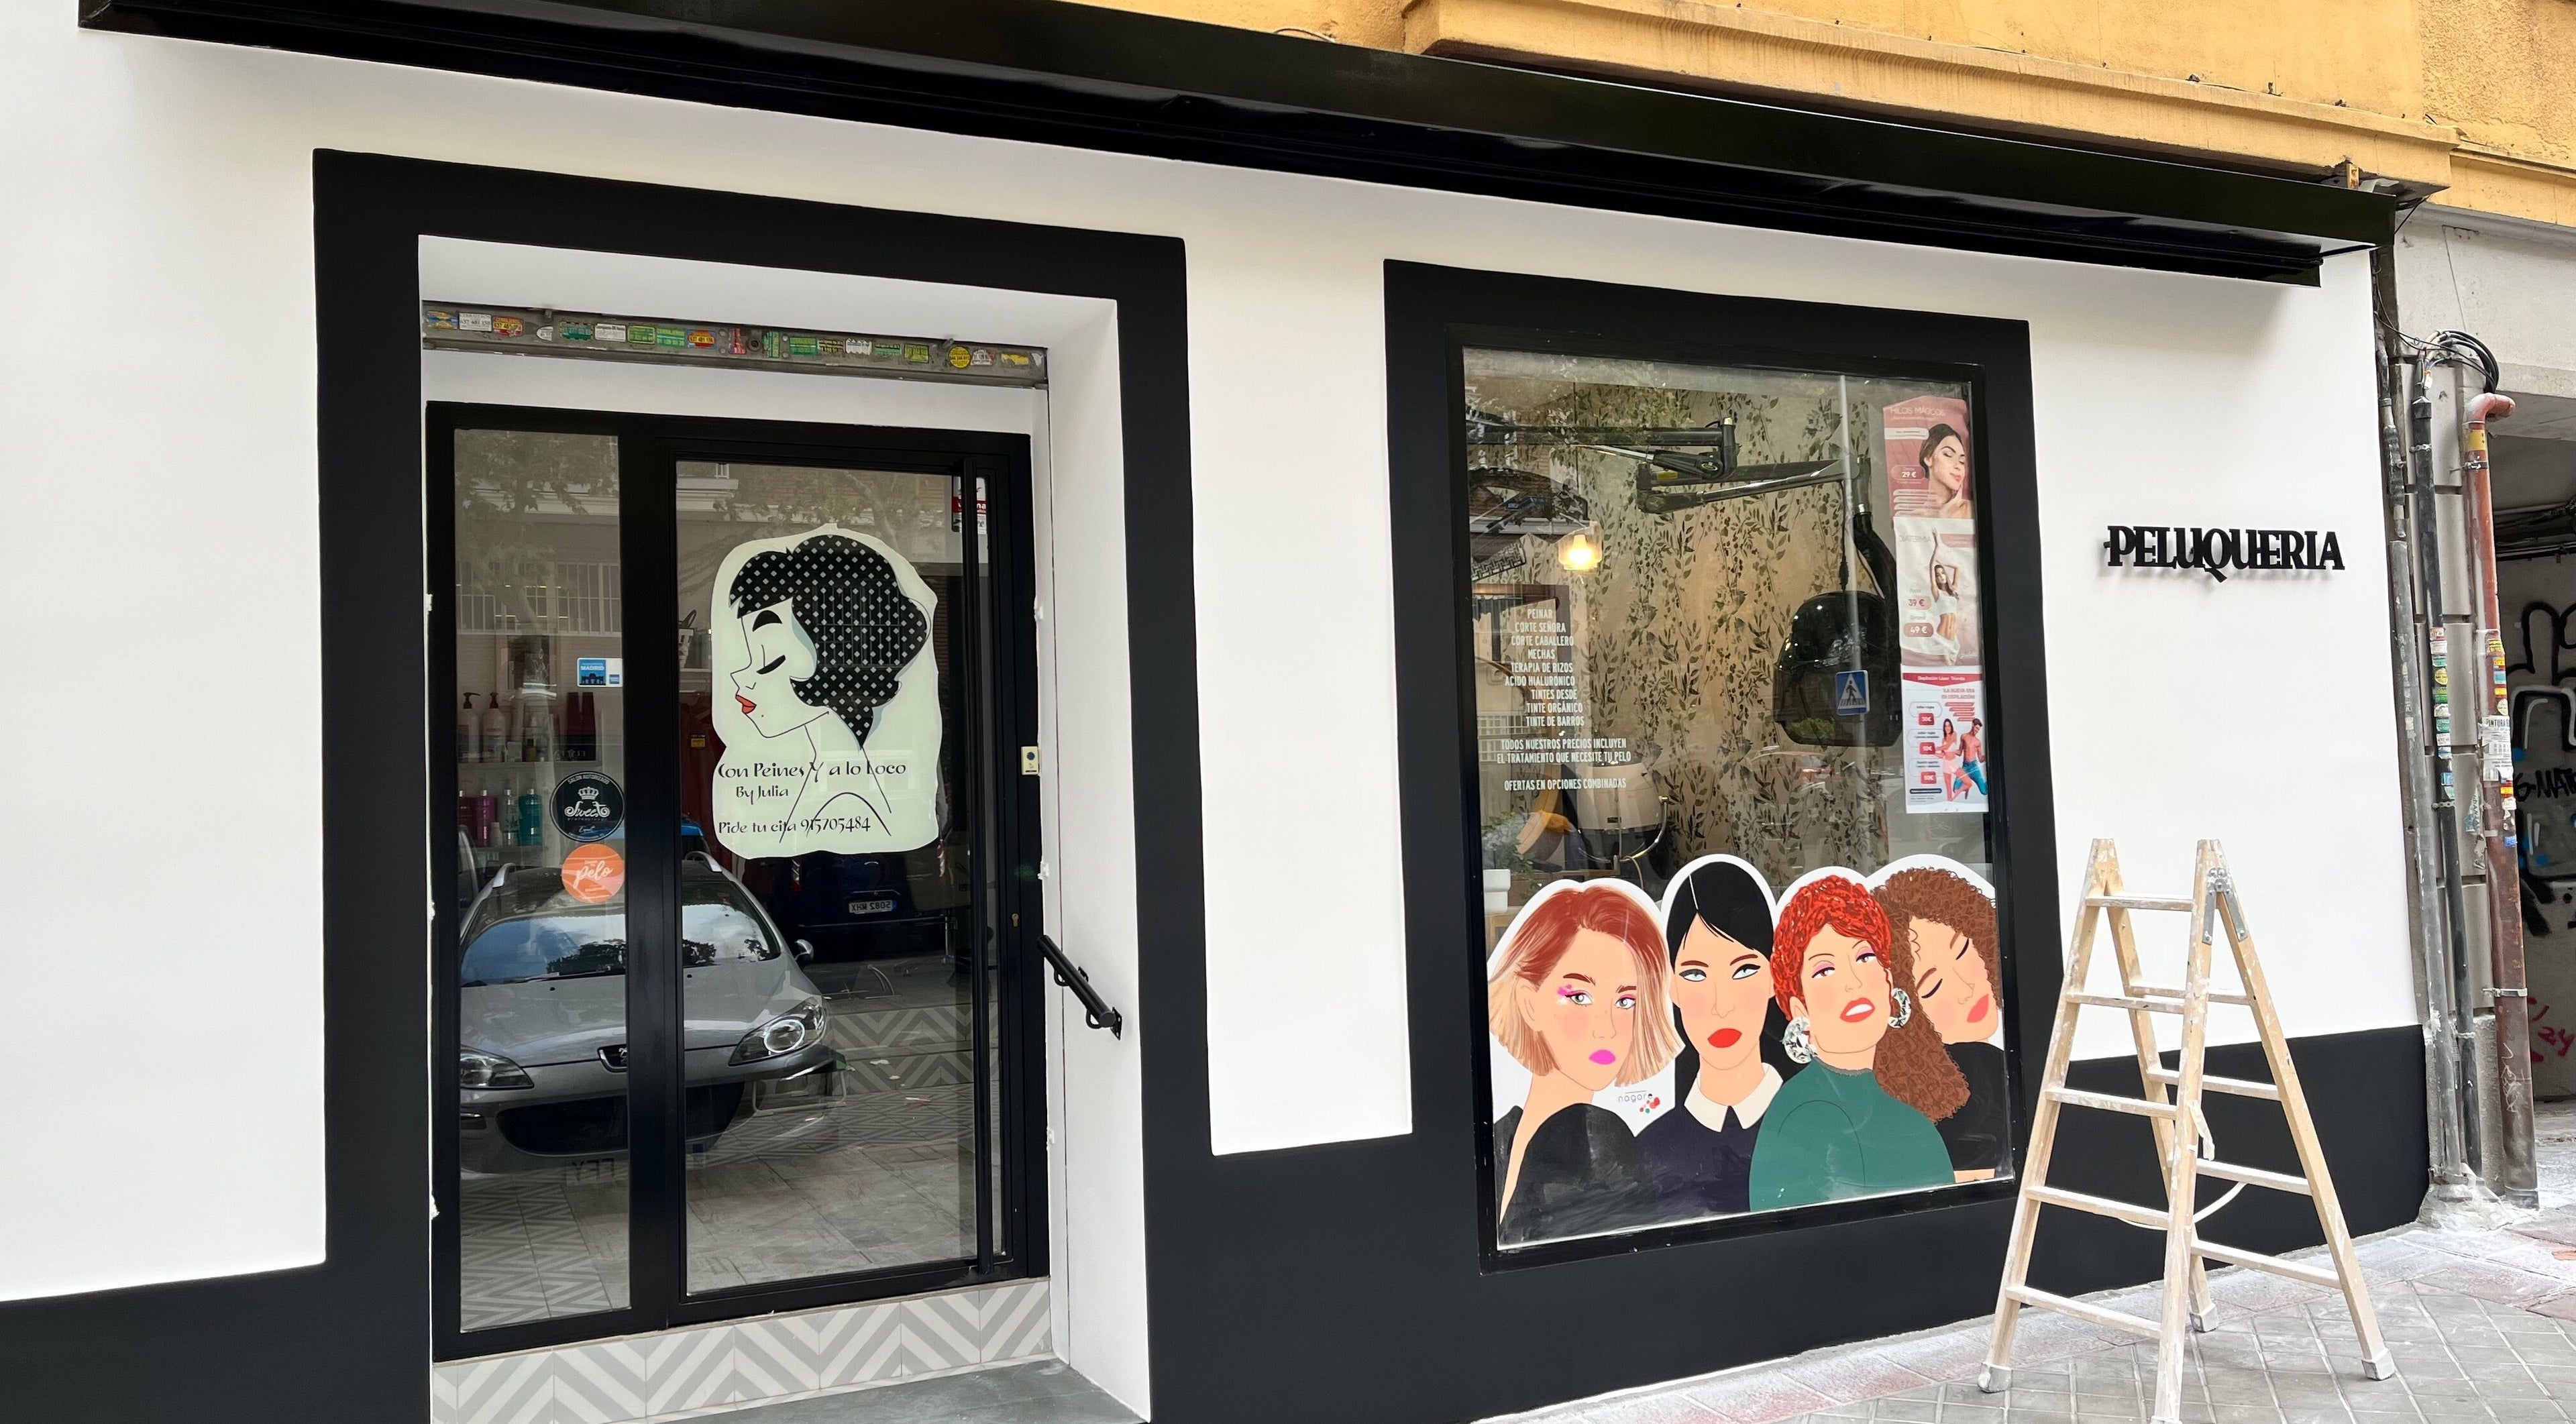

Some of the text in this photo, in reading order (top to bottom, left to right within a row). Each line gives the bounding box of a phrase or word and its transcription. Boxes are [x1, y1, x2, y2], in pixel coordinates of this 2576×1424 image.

[2107, 525, 2346, 583] PELUQUERIA
[1527, 608, 1553, 619] PEINAR
[1515, 621, 1566, 633] CORTE SEÑORA
[1910, 626, 1920, 635] 49
[1511, 636, 1574, 647] CORTE CABALLERO
[1527, 649, 1556, 659] MECHAS
[1511, 662, 1573, 673] TERAPIA DE RIZOS
[1505, 675, 1575, 686] ACIDO HIALURONICO
[1531, 689, 1578, 700] TINTES DESDE
[1526, 701, 1583, 713] TINTE ORGÁNICO
[1525, 716, 1585, 726] TINTE DE BARROS
[1501, 738, 1627, 750] TODOS NUESTROS PRECIOS INCLUYEN
[1497, 751, 1631, 764] EL TRATAMIENTO QUE NECESITE TU PELO
[718, 763, 748, 778] Con
[753, 762, 804, 777] Peines
[828, 765, 841, 776] a
[846, 761, 861, 775] lo
[1504, 778, 1627, 791] OFERTAS EN OPCIONES COMBINADAS
[736, 785, 790, 806] By Julia
[718, 816, 871, 835] Pide tu cita 915705484
[572, 860, 614, 889] pelo
